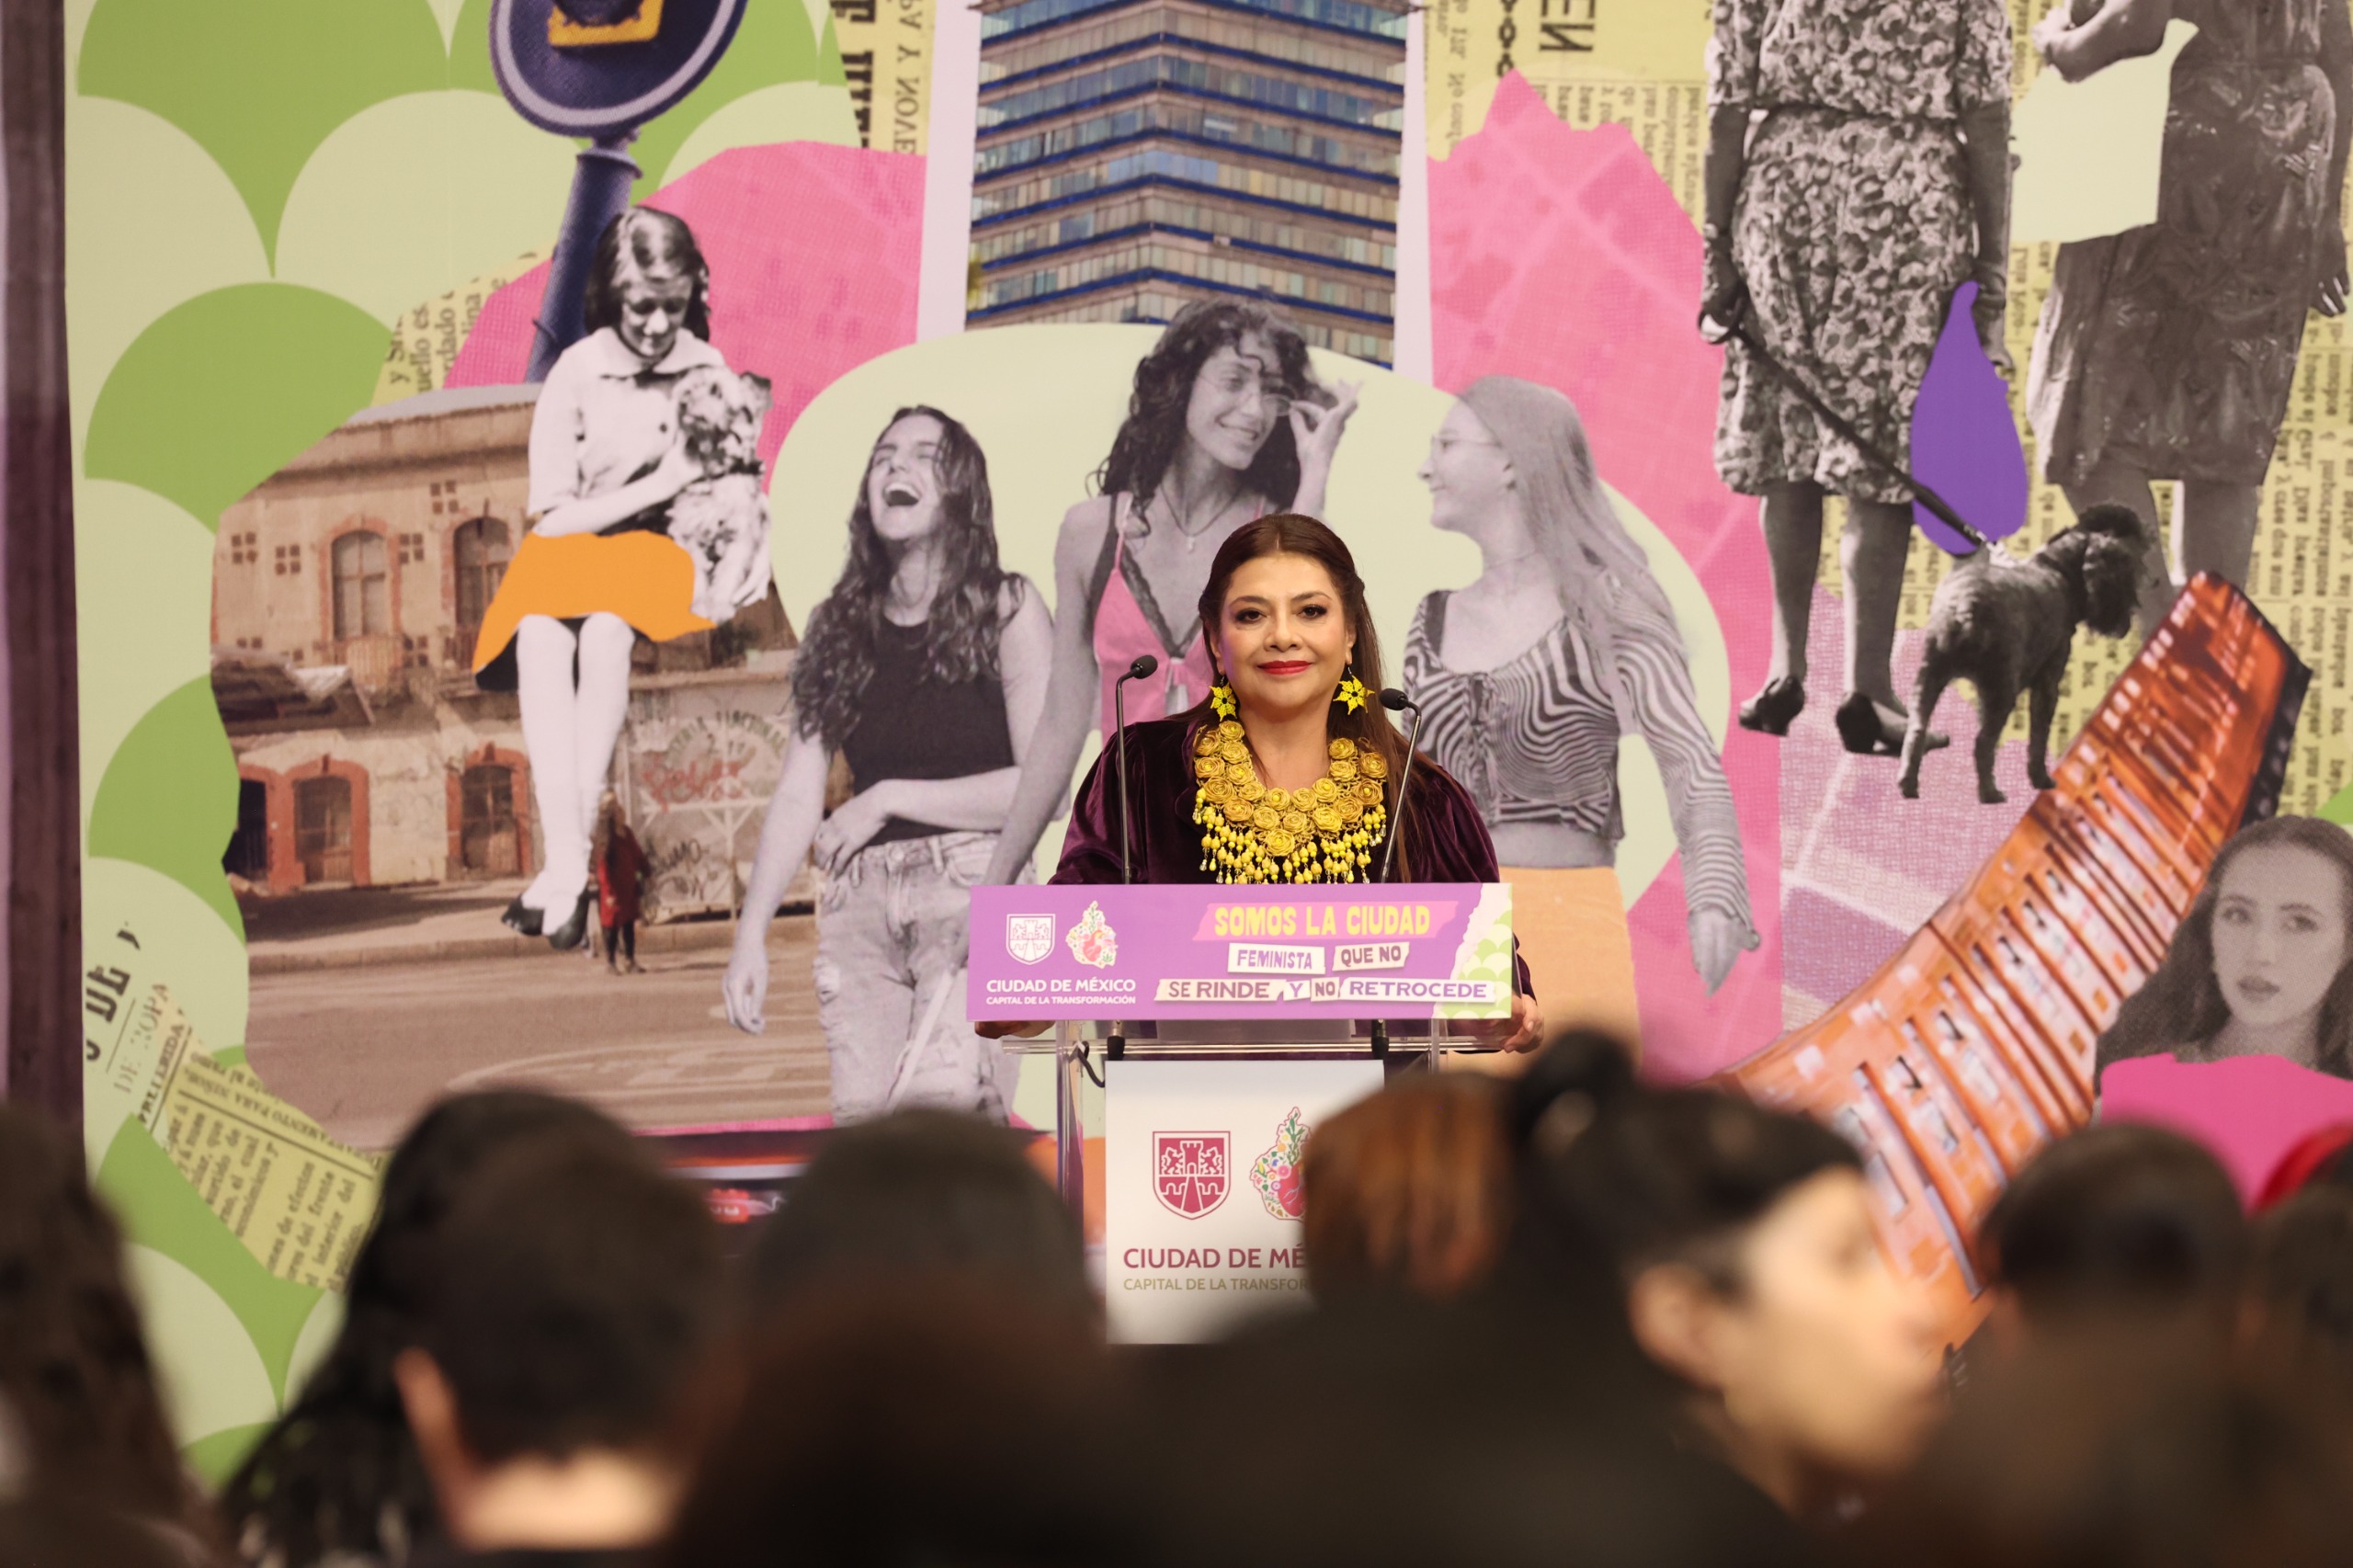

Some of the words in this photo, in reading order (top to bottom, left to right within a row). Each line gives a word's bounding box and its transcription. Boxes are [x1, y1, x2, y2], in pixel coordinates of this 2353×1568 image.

[1214, 905, 1297, 937] SOMOS
[1305, 905, 1336, 936] LA
[1346, 904, 1430, 935] CIUDAD
[1237, 949, 1313, 970] FEMINISTA
[1340, 947, 1373, 968] QUE
[1380, 945, 1402, 963] NO
[986, 979, 1047, 993] CIUDAD
[1051, 979, 1072, 993] DE
[1075, 976, 1136, 993] MÉXICO
[1168, 981, 1191, 998] SE
[1197, 981, 1270, 998] RINDE
[1289, 983, 1304, 998] Y
[1314, 981, 1336, 997] NO
[1349, 981, 1487, 998] RETROCEDE
[986, 996, 1023, 1005] CAPITAL
[1024, 996, 1037, 1005] DE
[1039, 996, 1050, 1005] LA
[1051, 994, 1136, 1005] TRANSFORMACIÓN
[1123, 1248, 1221, 1268] CIUDAD
[1229, 1248, 1262, 1268] DE
[1269, 1244, 1306, 1268] MÉ
[1123, 1278, 1183, 1290] CAPITAL
[1186, 1278, 1205, 1290] DE
[1210, 1278, 1226, 1290] LA
[1231, 1278, 1307, 1290] TRANSFOR
